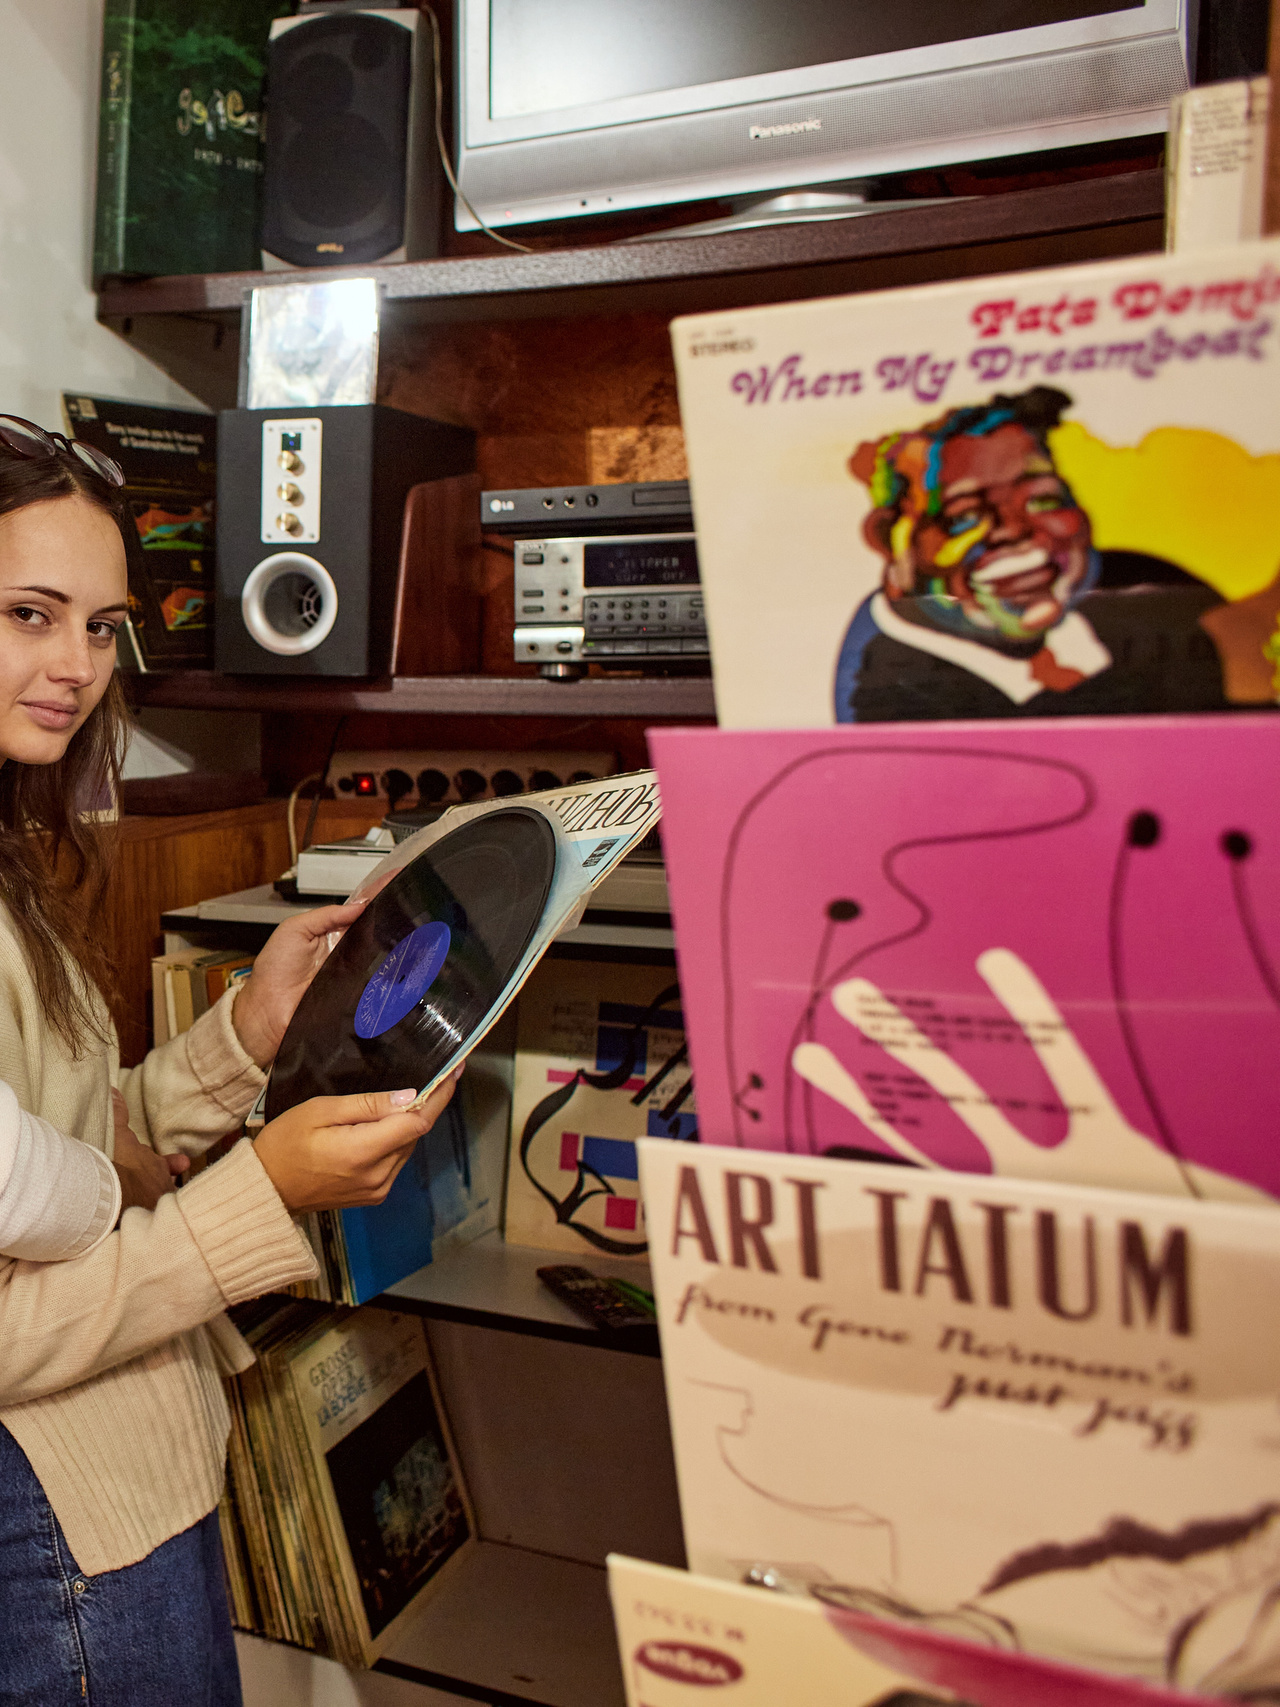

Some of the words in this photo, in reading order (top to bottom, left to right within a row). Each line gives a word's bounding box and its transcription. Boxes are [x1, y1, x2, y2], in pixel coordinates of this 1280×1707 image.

[749, 117, 822, 140] Panasonic
[970, 292, 1100, 339] Fats
[730, 353, 863, 406] When
[874, 352, 956, 402] My
[968, 319, 1272, 384] Dreamboat
[670, 1163, 827, 1283] ART
[863, 1187, 1194, 1339] TATUM
[676, 1282, 778, 1326] from
[797, 1302, 911, 1352] Gene
[934, 1370, 1068, 1411] just
[1073, 1398, 1197, 1453] jazz
